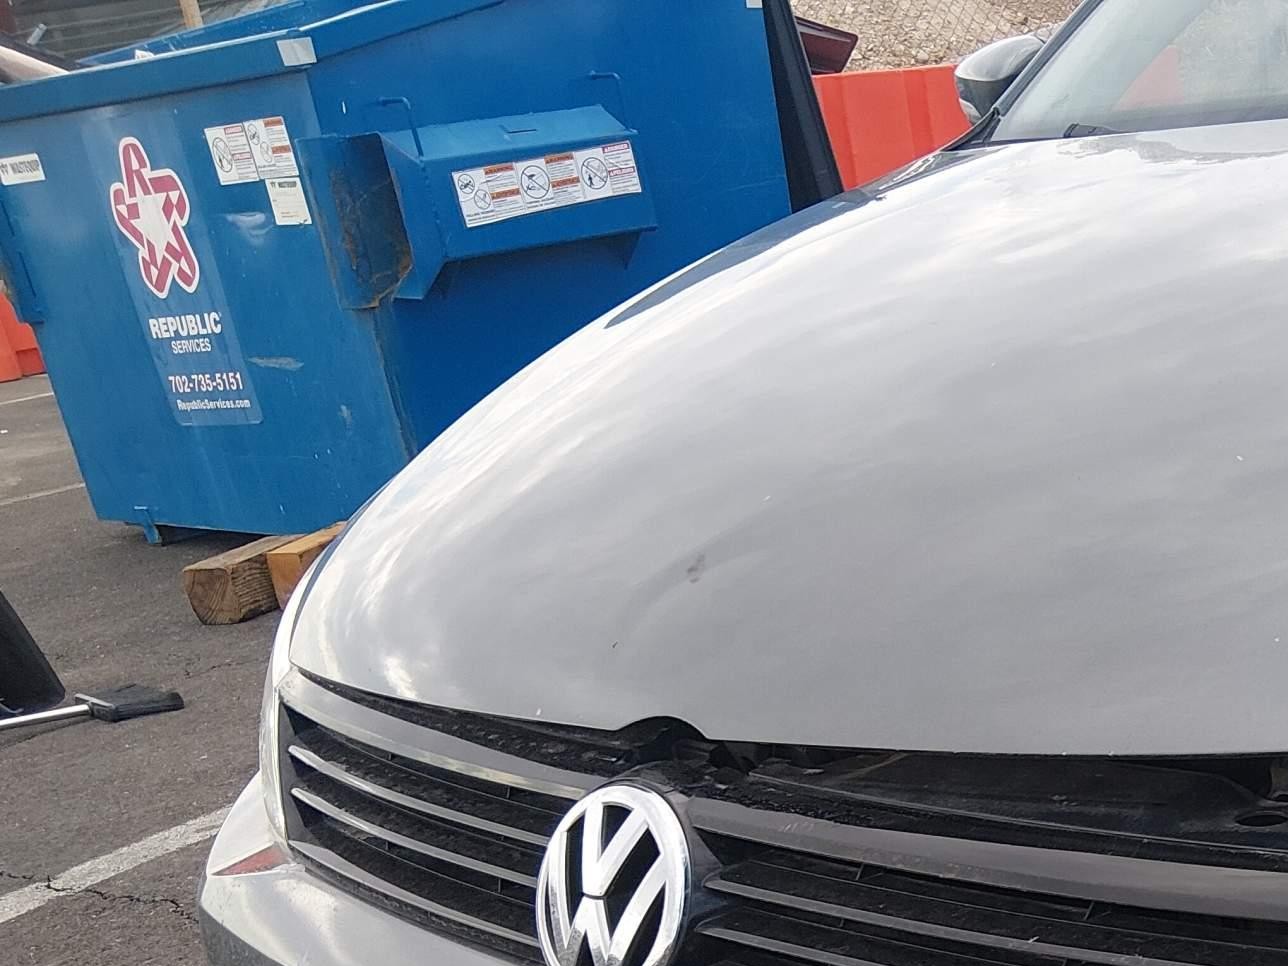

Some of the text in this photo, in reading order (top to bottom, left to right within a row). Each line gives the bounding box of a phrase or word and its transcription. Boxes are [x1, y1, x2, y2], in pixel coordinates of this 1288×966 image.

[149, 311, 222, 339] REPUBLIC
[171, 338, 212, 354] SERVICES
[168, 371, 244, 393] 702-735-5151
[176, 398, 251, 412] RepublicServices.com
